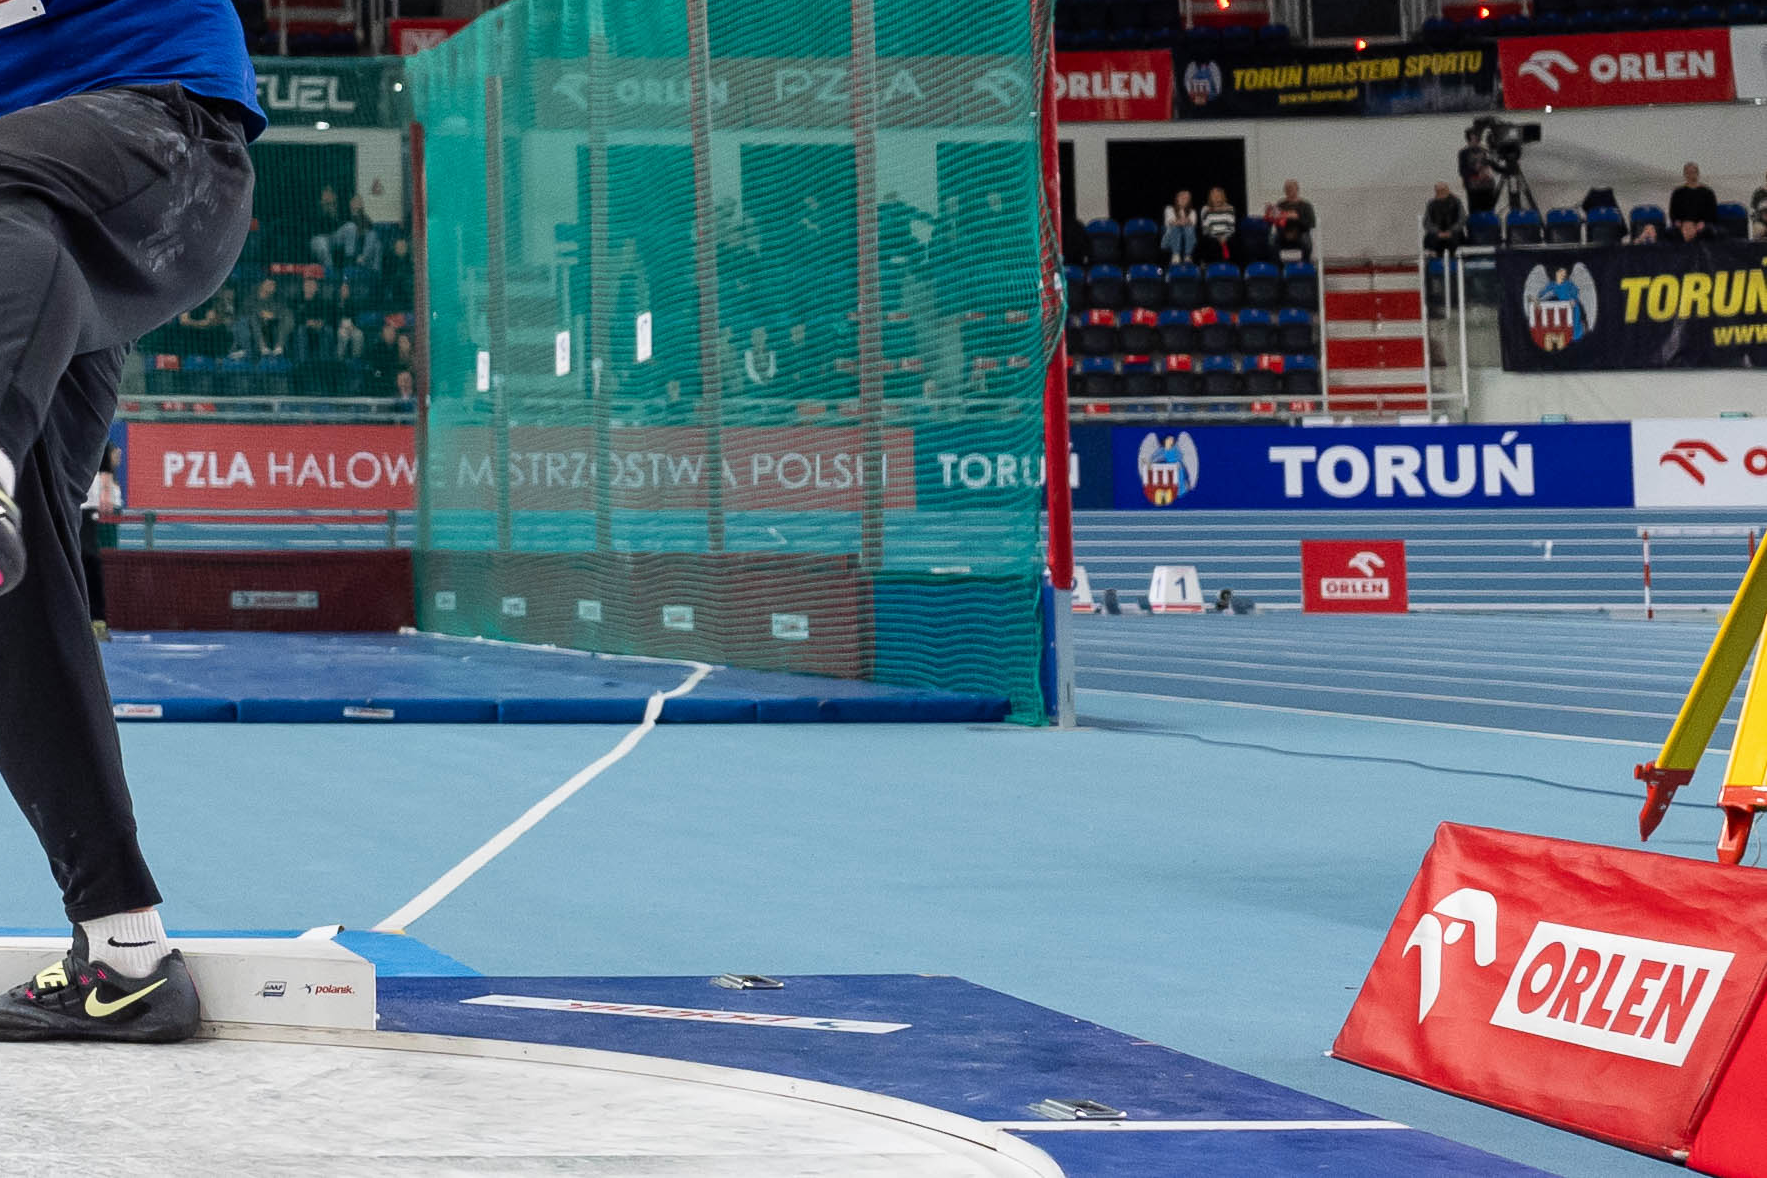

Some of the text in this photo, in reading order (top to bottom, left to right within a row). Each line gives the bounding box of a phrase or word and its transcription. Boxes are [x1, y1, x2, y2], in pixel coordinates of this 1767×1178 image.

[1307, 58, 1400, 87] MIASTEM
[1404, 50, 1483, 78] SPORTU
[1590, 49, 1717, 84] ORLEN
[775, 68, 924, 103] PZA
[163, 451, 256, 488] PZLA
[1268, 431, 1535, 498] TORUŃ
[1174, 577, 1188, 601] 1
[1326, 582, 1385, 595] ORLEN
[315, 984, 353, 995] polanik
[1517, 941, 1710, 1045] ORLEN
